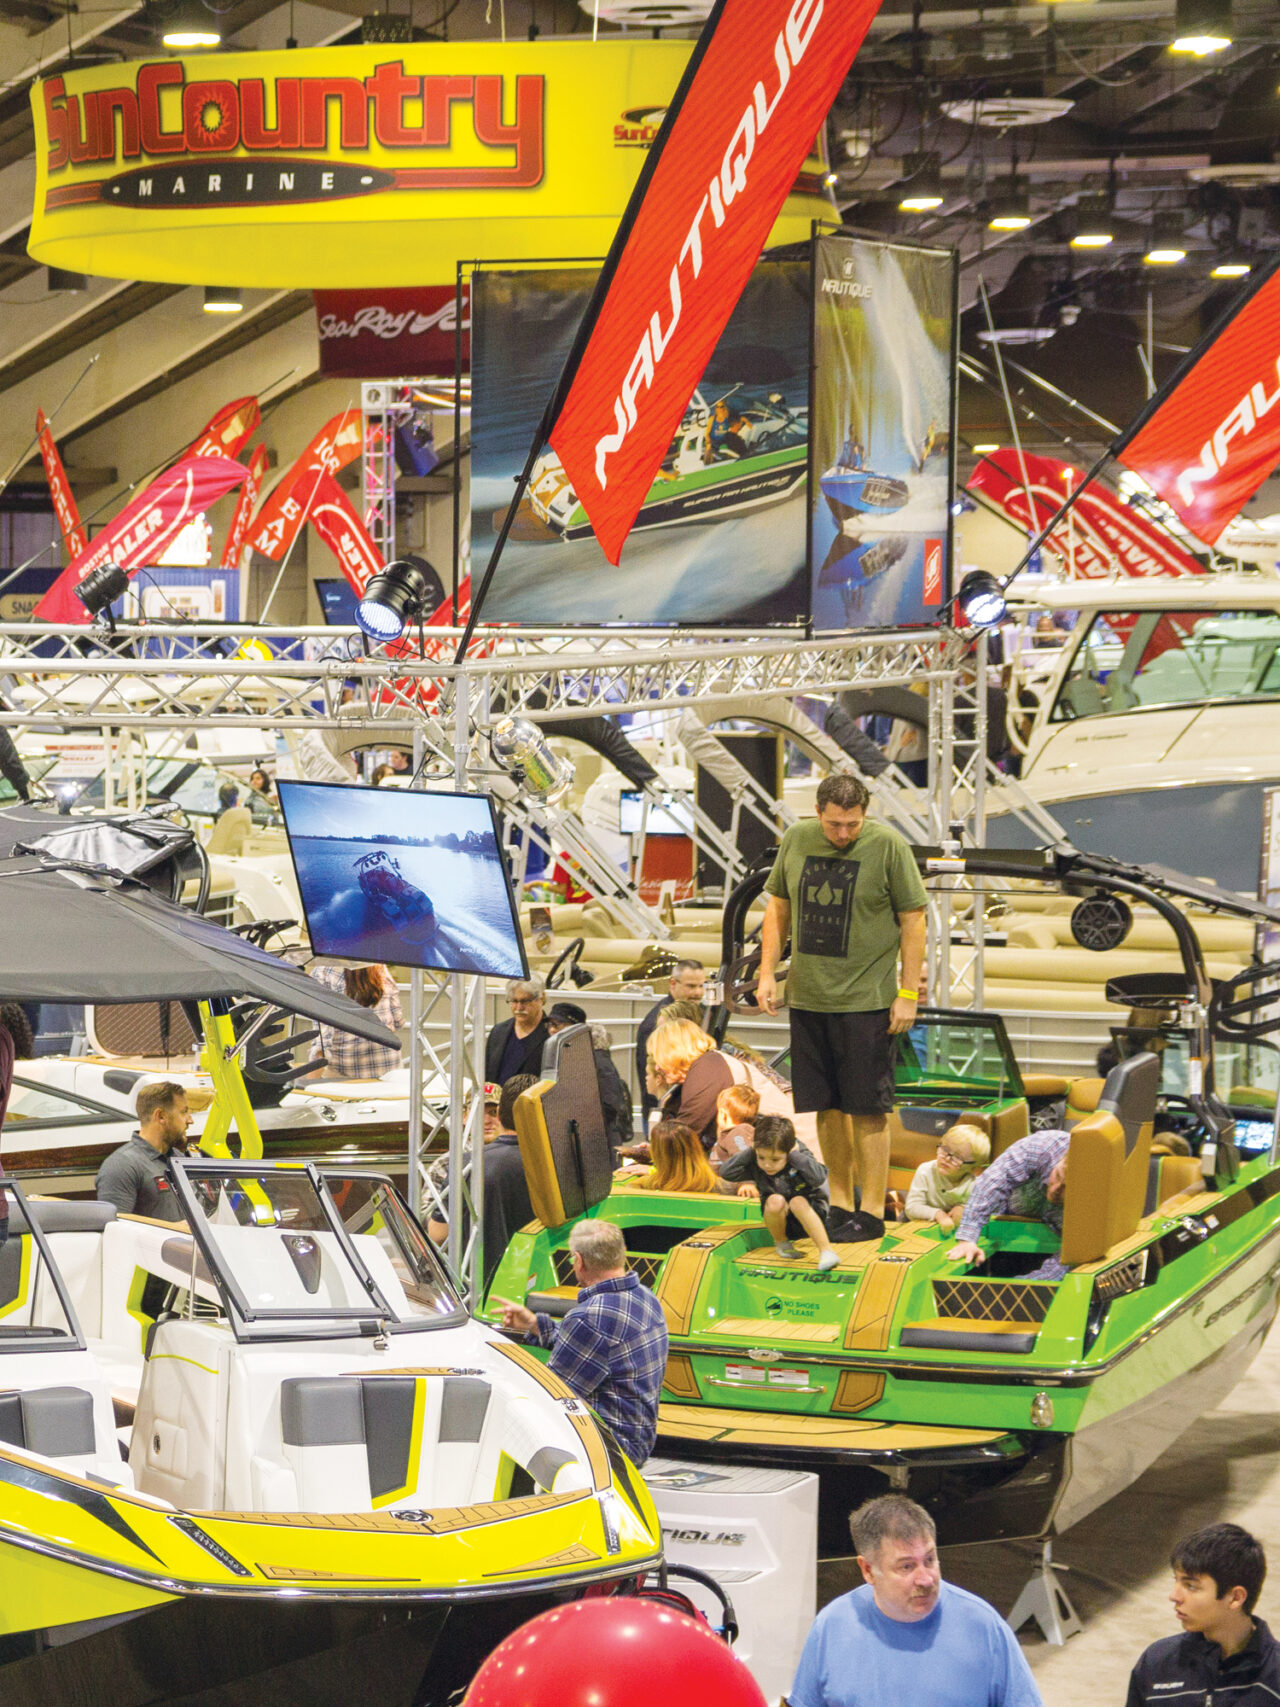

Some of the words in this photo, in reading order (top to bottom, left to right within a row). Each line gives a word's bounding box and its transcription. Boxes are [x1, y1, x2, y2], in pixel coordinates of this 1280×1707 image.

[43, 58, 546, 190] SunCountry
[138, 172, 336, 197] MARINE
[595, 0, 824, 491] NAUTIQUE
[821, 278, 872, 298] NAUTIQUE
[320, 314, 354, 341] Sea
[350, 306, 416, 339] Ray
[98, 507, 165, 568] ALER
[78, 542, 111, 580] BOSTON
[738, 1268, 859, 1285] NAUTIQUE
[783, 1300, 795, 1308] NO
[795, 1301, 820, 1310] SHOES
[787, 1309, 816, 1318] PLEASE
